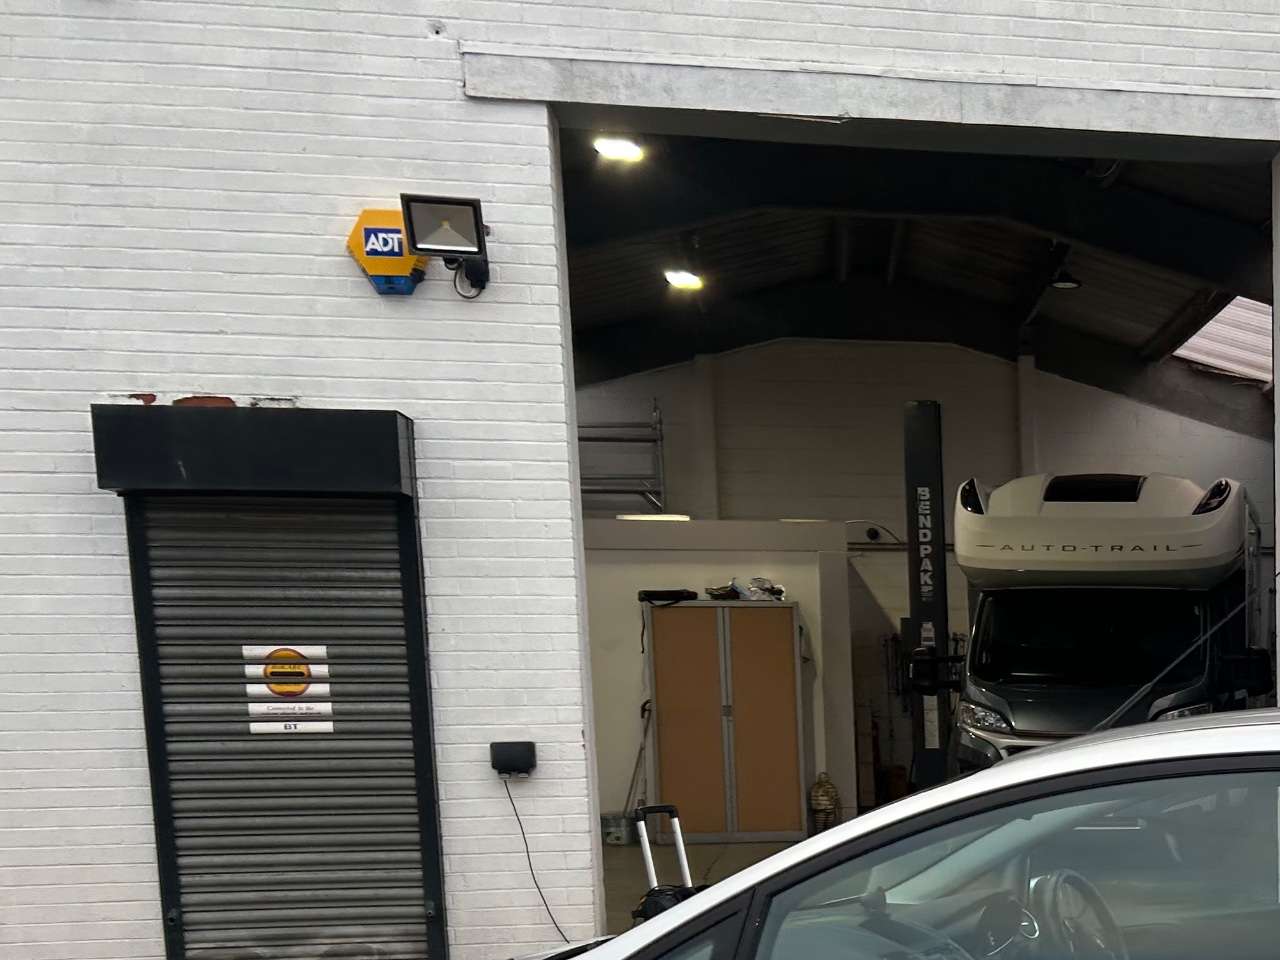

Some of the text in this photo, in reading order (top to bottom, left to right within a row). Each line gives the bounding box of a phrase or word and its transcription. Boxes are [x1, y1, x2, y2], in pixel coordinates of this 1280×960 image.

[365, 232, 403, 252] ADT
[916, 487, 933, 585] BENDPAK
[1000, 543, 1178, 552] AUTO-TRAIL
